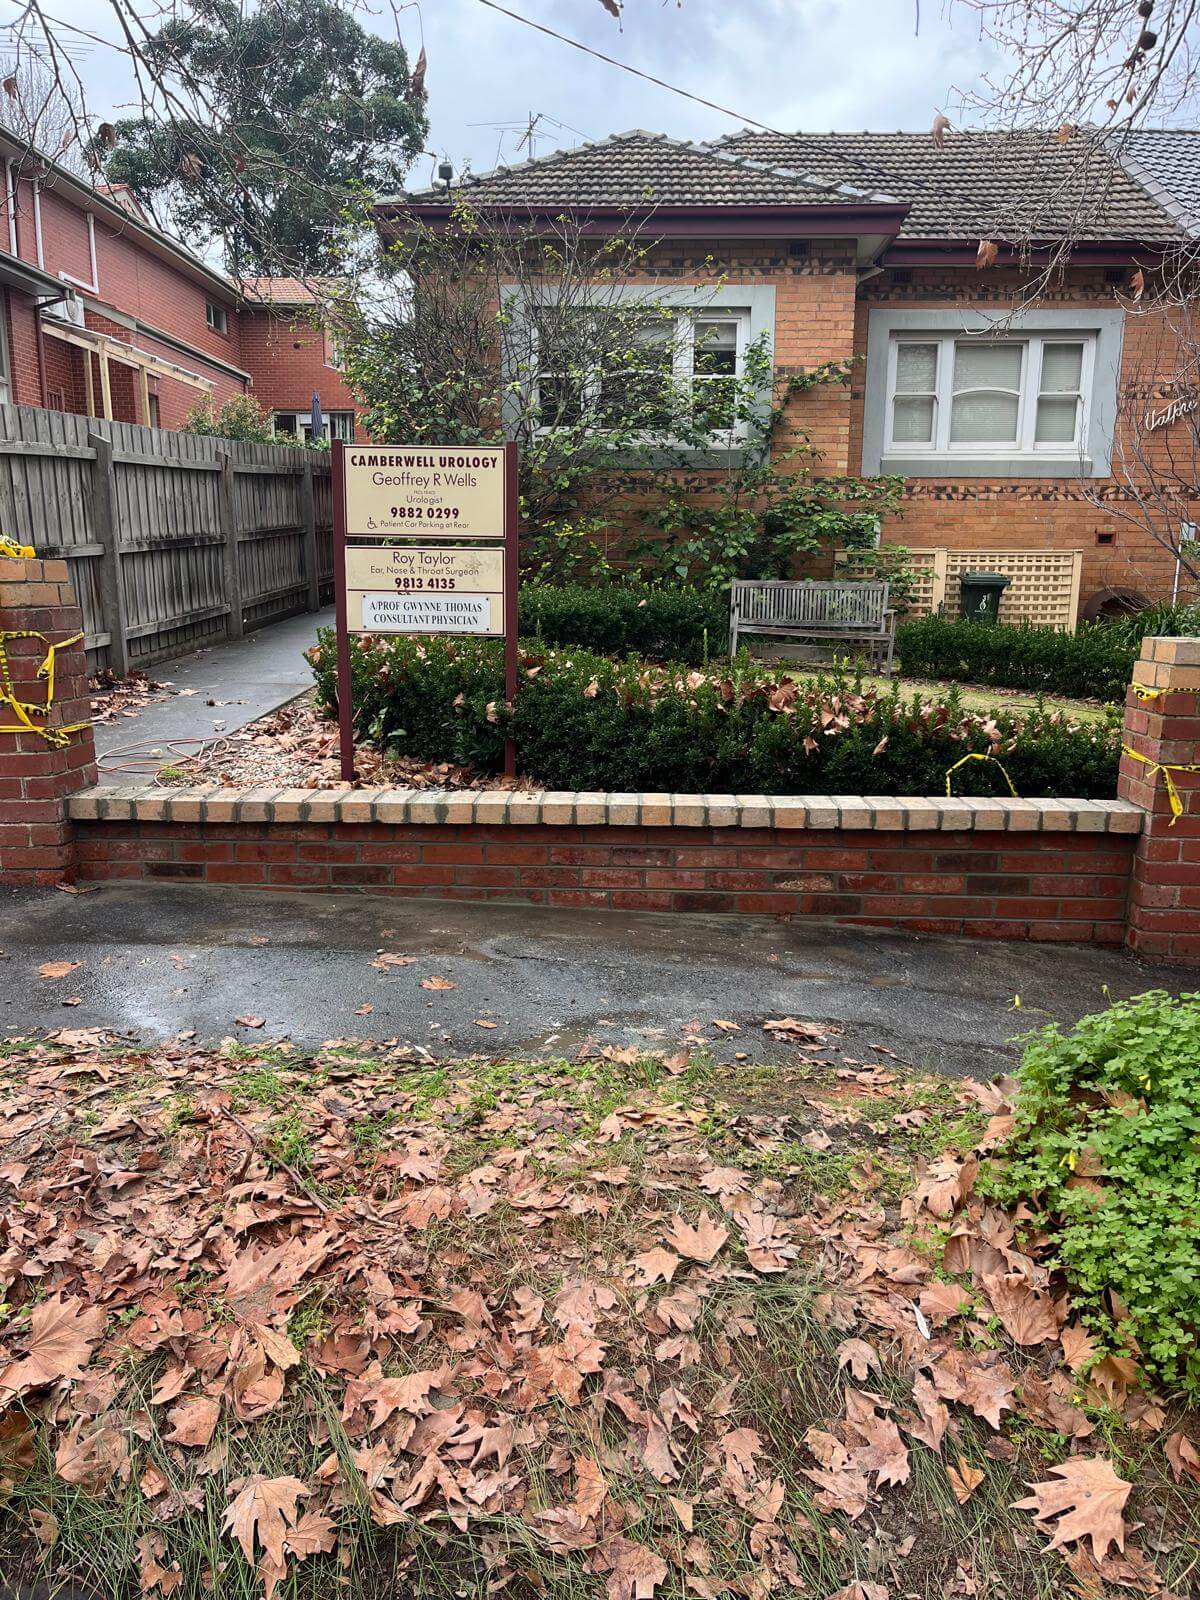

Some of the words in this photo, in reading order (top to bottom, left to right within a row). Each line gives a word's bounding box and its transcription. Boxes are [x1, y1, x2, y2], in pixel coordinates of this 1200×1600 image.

[351, 455, 435, 467] CAMBERWELL
[440, 456, 497, 468] UROLOGY
[372, 472, 430, 489] Geoffrey
[434, 474, 441, 486] R
[445, 473, 477, 487] Wells
[407, 495, 442, 504] Urologist
[391, 507, 422, 518] 9882
[428, 508, 459, 519] 0299
[419, 521, 444, 529] Parking
[393, 551, 415, 566] Roy
[418, 552, 456, 566] Taylor
[446, 568, 479, 576] Surgeon
[395, 578, 423, 588] 9813
[428, 579, 455, 589] 4135
[404, 602, 441, 611] GWYNNE
[444, 603, 482, 612] THOMAS
[374, 614, 429, 624] CONSULTANT
[432, 615, 478, 625] PHYSICIAN
